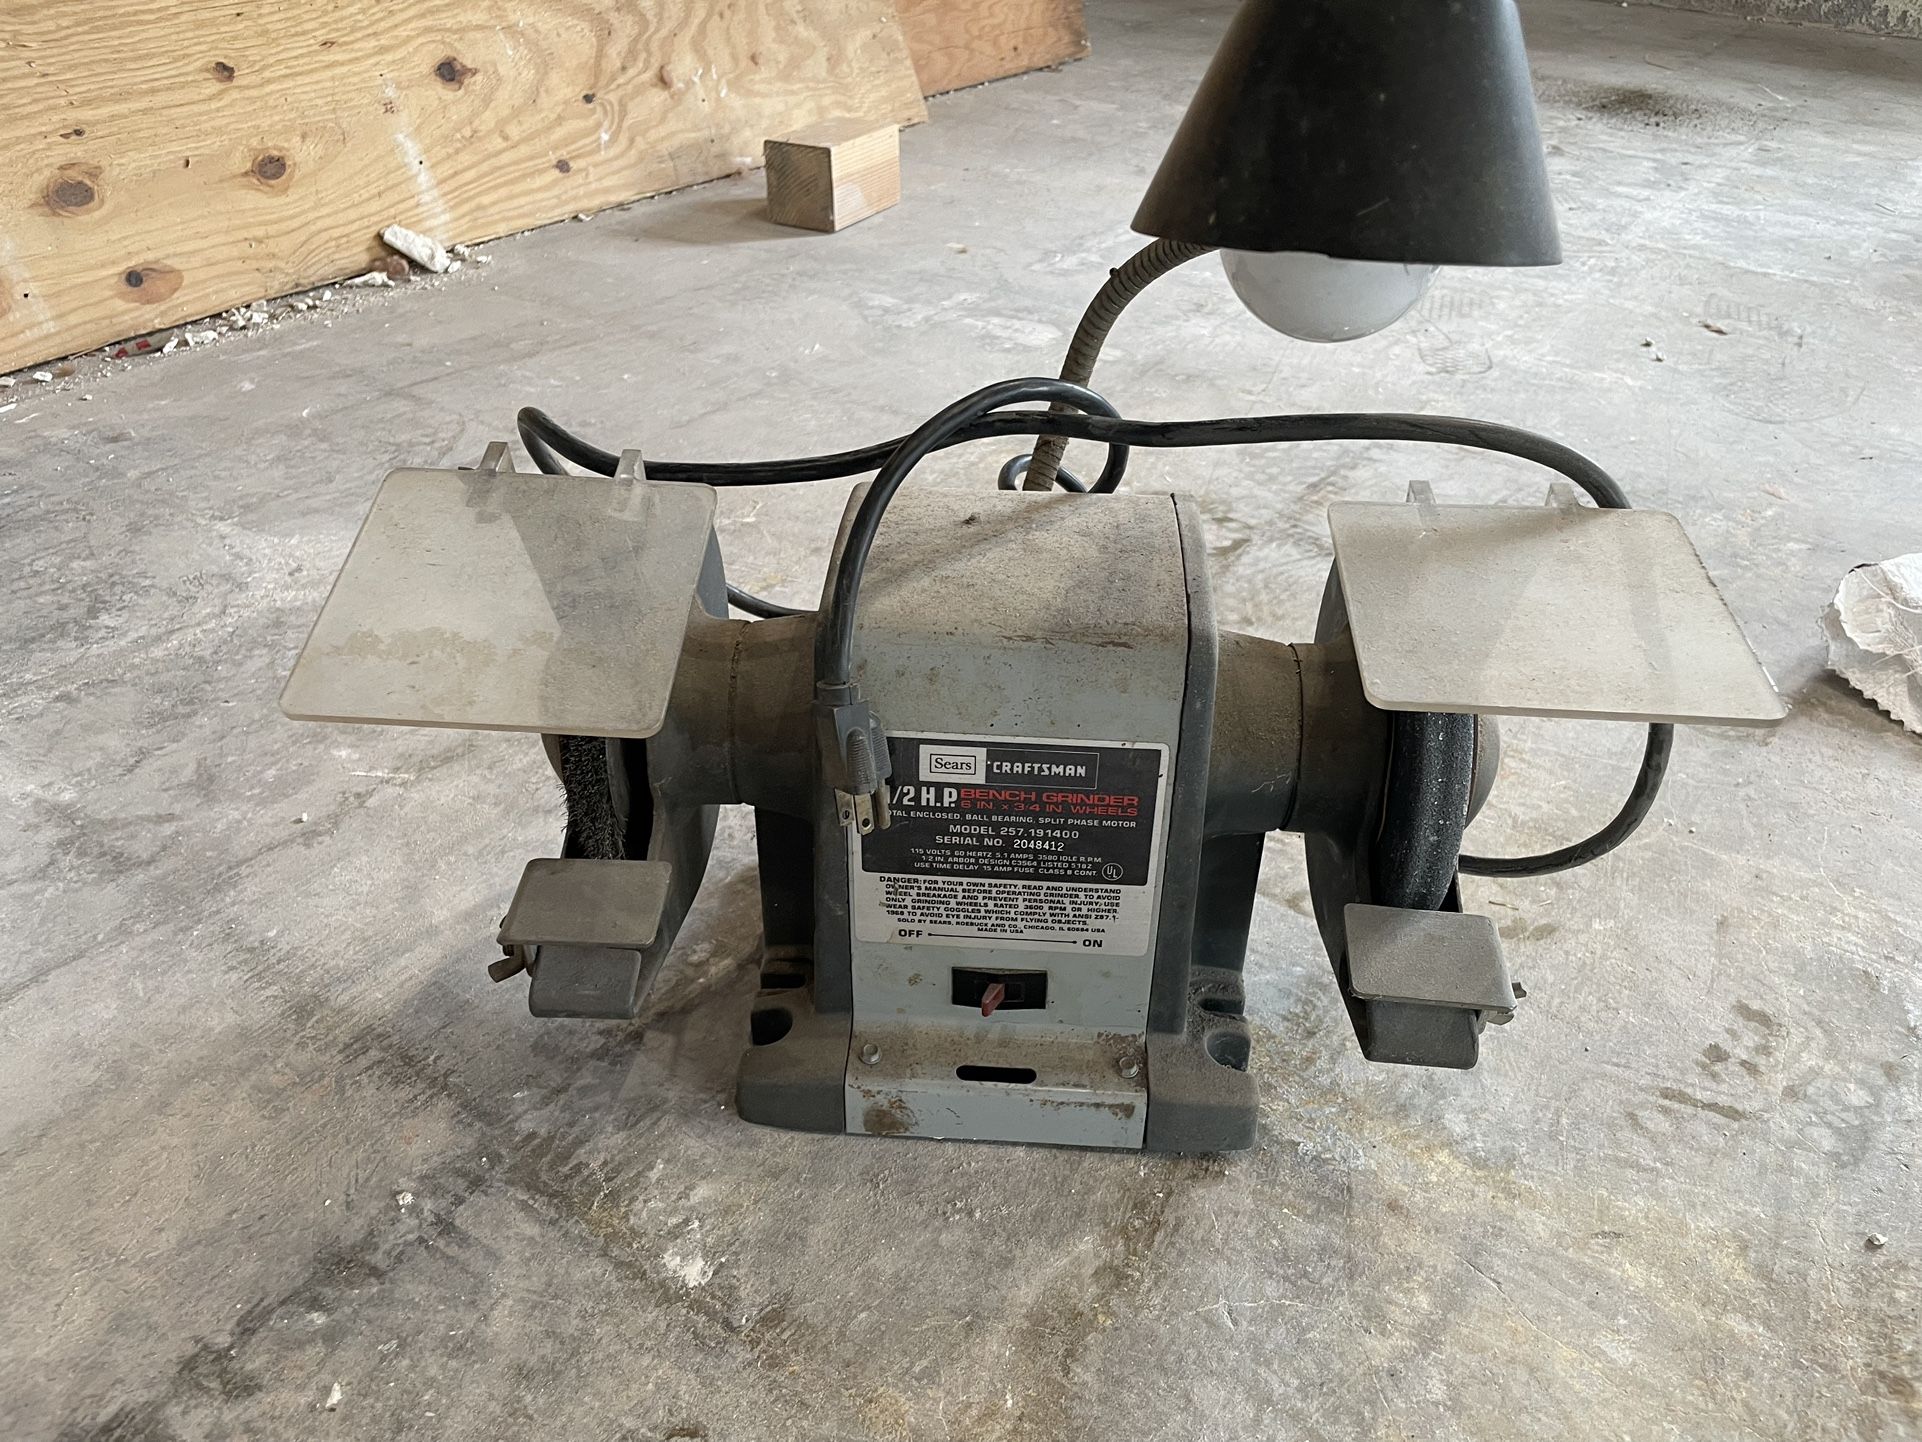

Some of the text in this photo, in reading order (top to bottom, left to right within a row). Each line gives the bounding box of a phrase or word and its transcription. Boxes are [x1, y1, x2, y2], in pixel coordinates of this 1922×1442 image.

[934, 757, 1086, 777] Sears CRAFTSMAN
[921, 786, 958, 808] H.P.
[960, 788, 1036, 802] BENCH
[1042, 792, 1139, 806] GRINDER
[961, 800, 971, 809] 6
[1071, 805, 1138, 816] WHEELS
[965, 813, 989, 821] BALL
[1038, 817, 1065, 825] SPLIT
[1067, 818, 1099, 827] PHASE
[1102, 820, 1137, 828] MOTOR
[949, 824, 1080, 839] MODEL 257.191400
[935, 835, 1065, 852] SERIAL NO. 2048412
[978, 858, 1010, 866] DESIGN
[953, 863, 979, 871] DELAY
[1038, 868, 1065, 876] CLASS
[879, 876, 922, 885] DANGER:
[1065, 886, 1122, 895] UNDERSTAND
[924, 885, 960, 893] MANUAL
[995, 889, 1041, 898] OPERATING
[885, 896, 906, 904] ONLY
[911, 898, 951, 906] GRINDING
[993, 902, 1019, 910] RATED
[916, 891, 959, 900] BREAKAGE
[982, 895, 1019, 903] PREVENT
[1022, 897, 1066, 906] PERSONAL
[919, 911, 943, 919] AVOID
[963, 914, 993, 922] INJURY
[1020, 917, 1049, 925] FLYING
[943, 906, 981, 915] GOGGLES
[984, 908, 1011, 916] WHICH
[1014, 910, 1047, 918] COMPLY
[955, 920, 989, 928] ROEBUCK
[898, 928, 923, 938] OFF
[1082, 939, 1103, 948] ON
